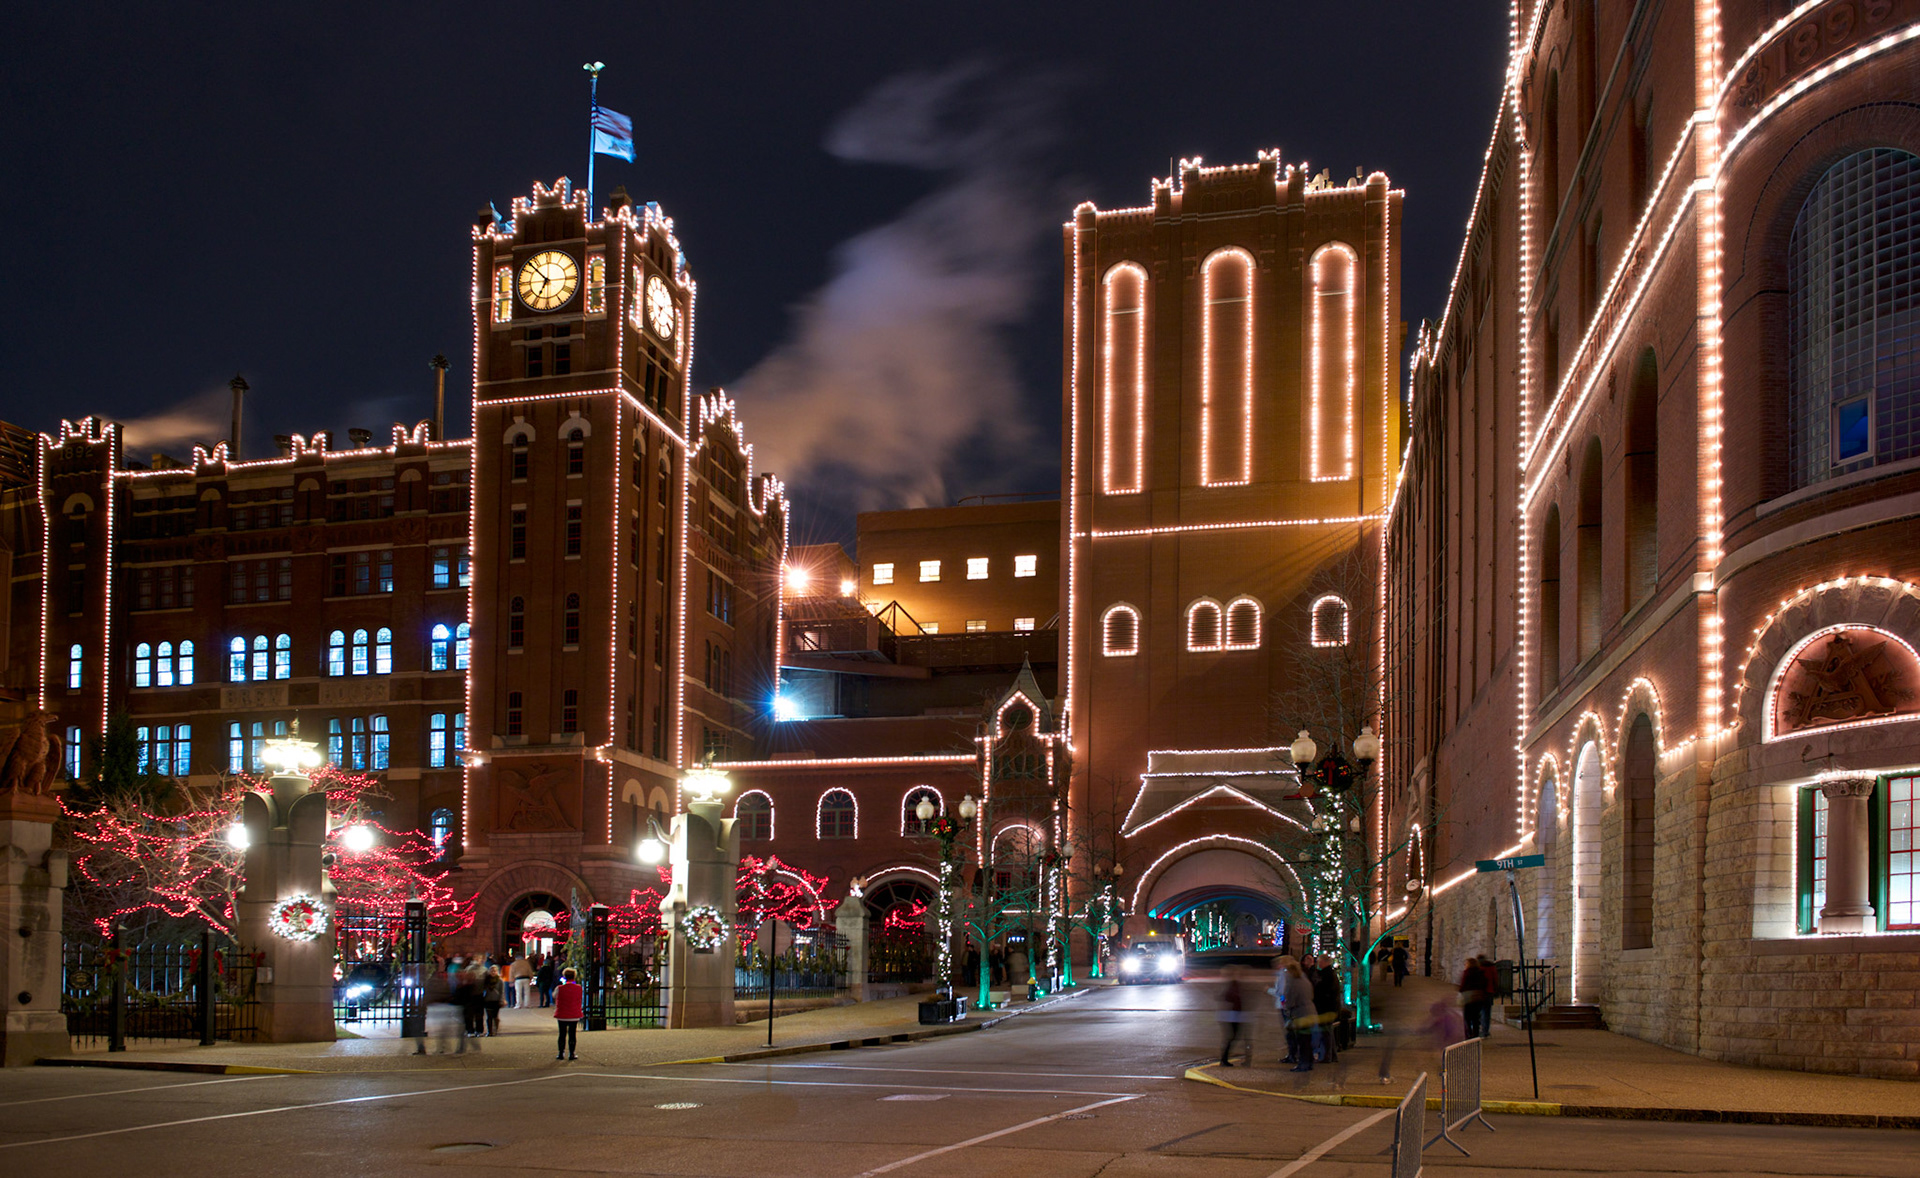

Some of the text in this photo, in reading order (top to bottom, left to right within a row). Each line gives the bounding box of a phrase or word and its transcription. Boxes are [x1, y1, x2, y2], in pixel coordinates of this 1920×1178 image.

[1778, 0, 1893, 79] 1898
[60, 445, 94, 460] 1892
[1496, 859, 1514, 869] 9TH
